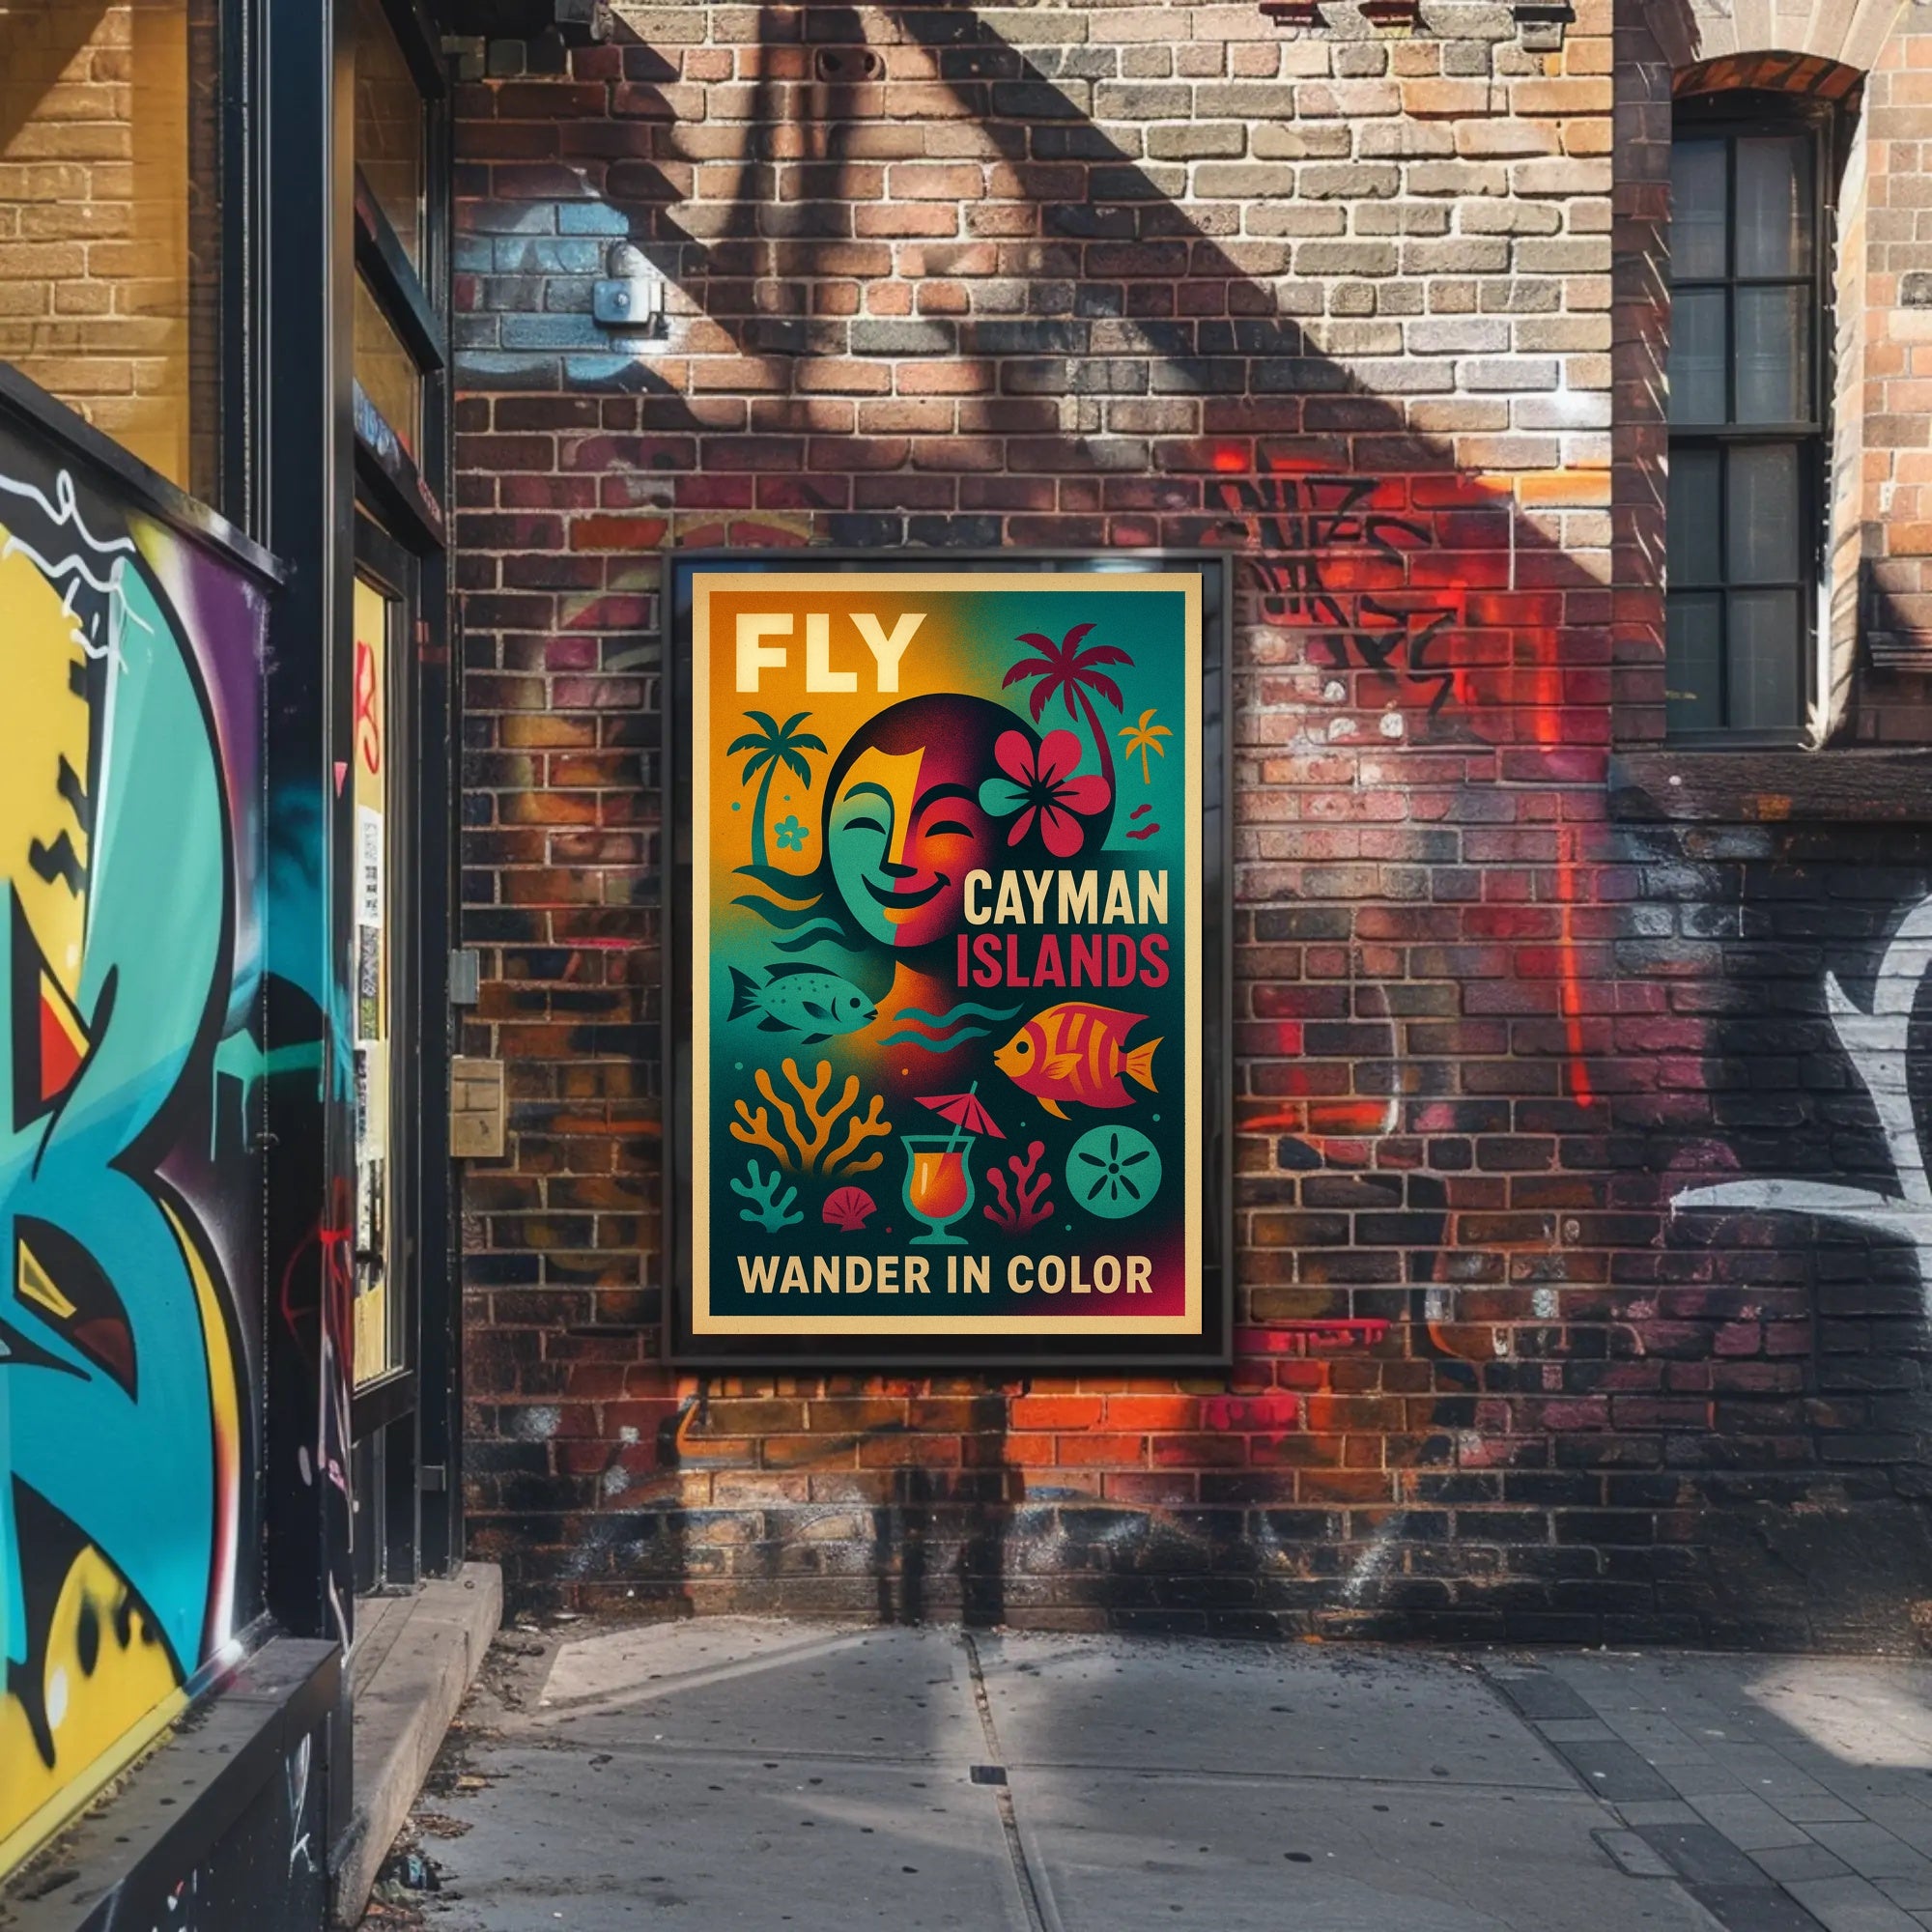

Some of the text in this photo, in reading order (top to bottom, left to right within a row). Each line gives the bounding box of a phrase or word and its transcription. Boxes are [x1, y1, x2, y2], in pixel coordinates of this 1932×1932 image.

[735, 612, 927, 694] FLY
[963, 868, 1169, 925] CAYMAN
[957, 933, 1170, 988] ISLANDS
[736, 1255, 1153, 1294] WANDER IN COLOR
